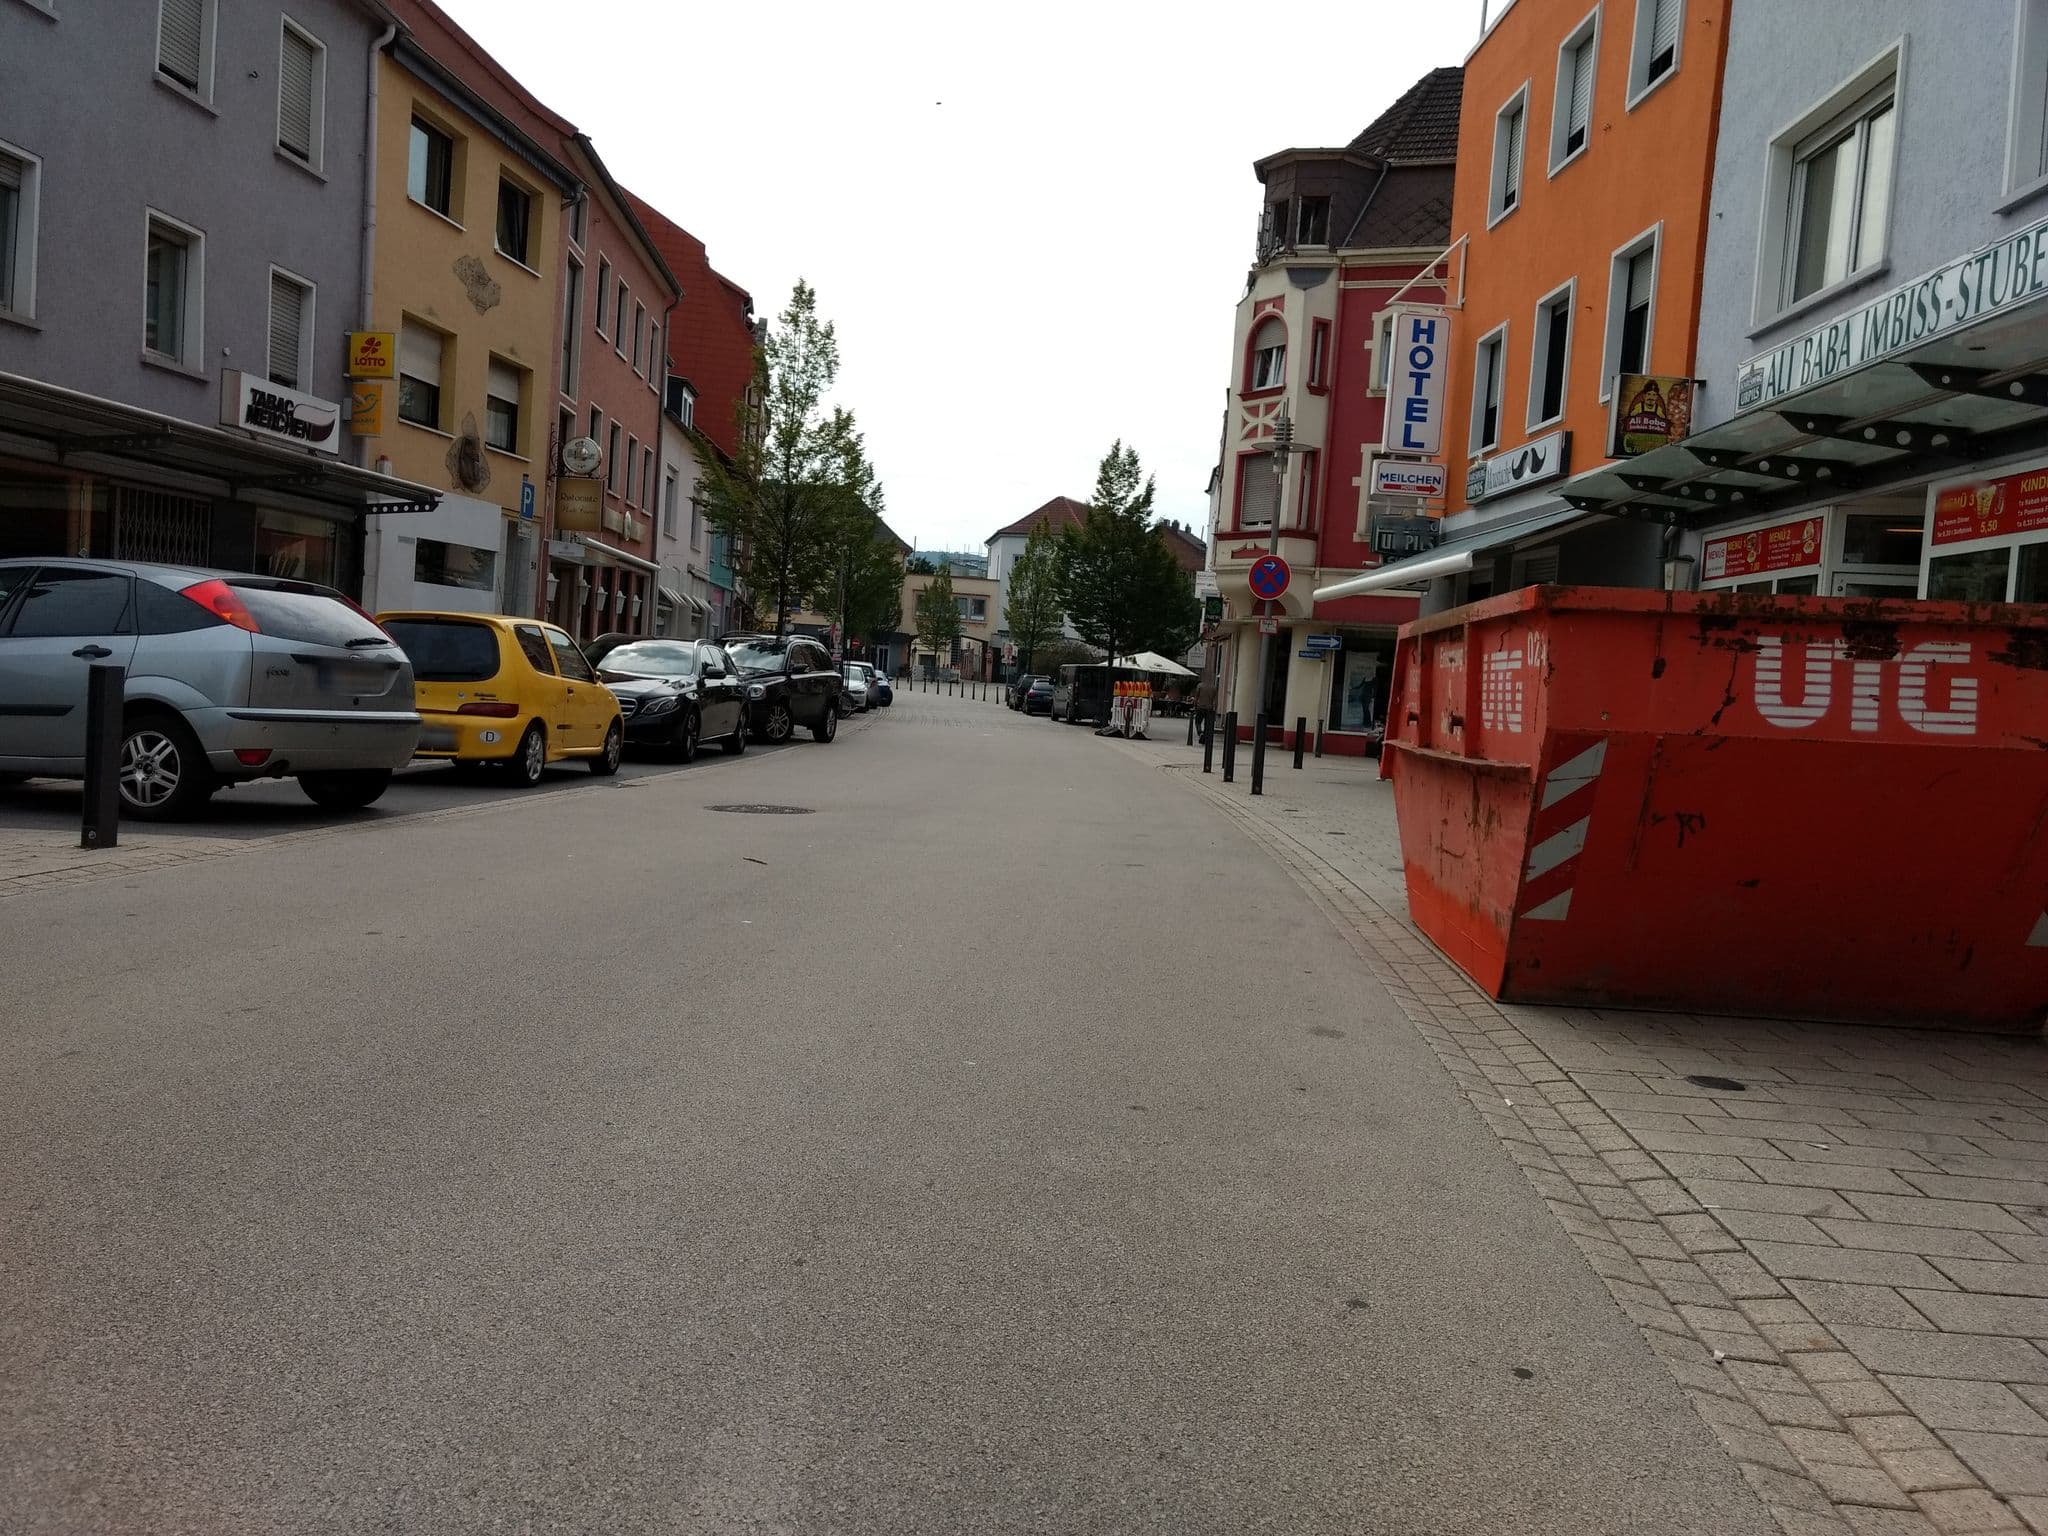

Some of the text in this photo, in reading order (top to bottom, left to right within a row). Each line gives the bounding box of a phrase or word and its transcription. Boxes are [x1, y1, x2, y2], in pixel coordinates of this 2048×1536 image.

[355, 357, 386, 367] LOTTO
[1765, 346, 1795, 400] ALI
[1800, 319, 1851, 386] BABA
[1403, 319, 1436, 449] HOTEL
[1379, 472, 1442, 485] MEILCHEN
[523, 487, 532, 513] P
[1980, 520, 1998, 534] 5,50
[1482, 650, 1523, 733] UTG
[1754, 636, 1979, 735] UTG
[485, 731, 495, 742] D
